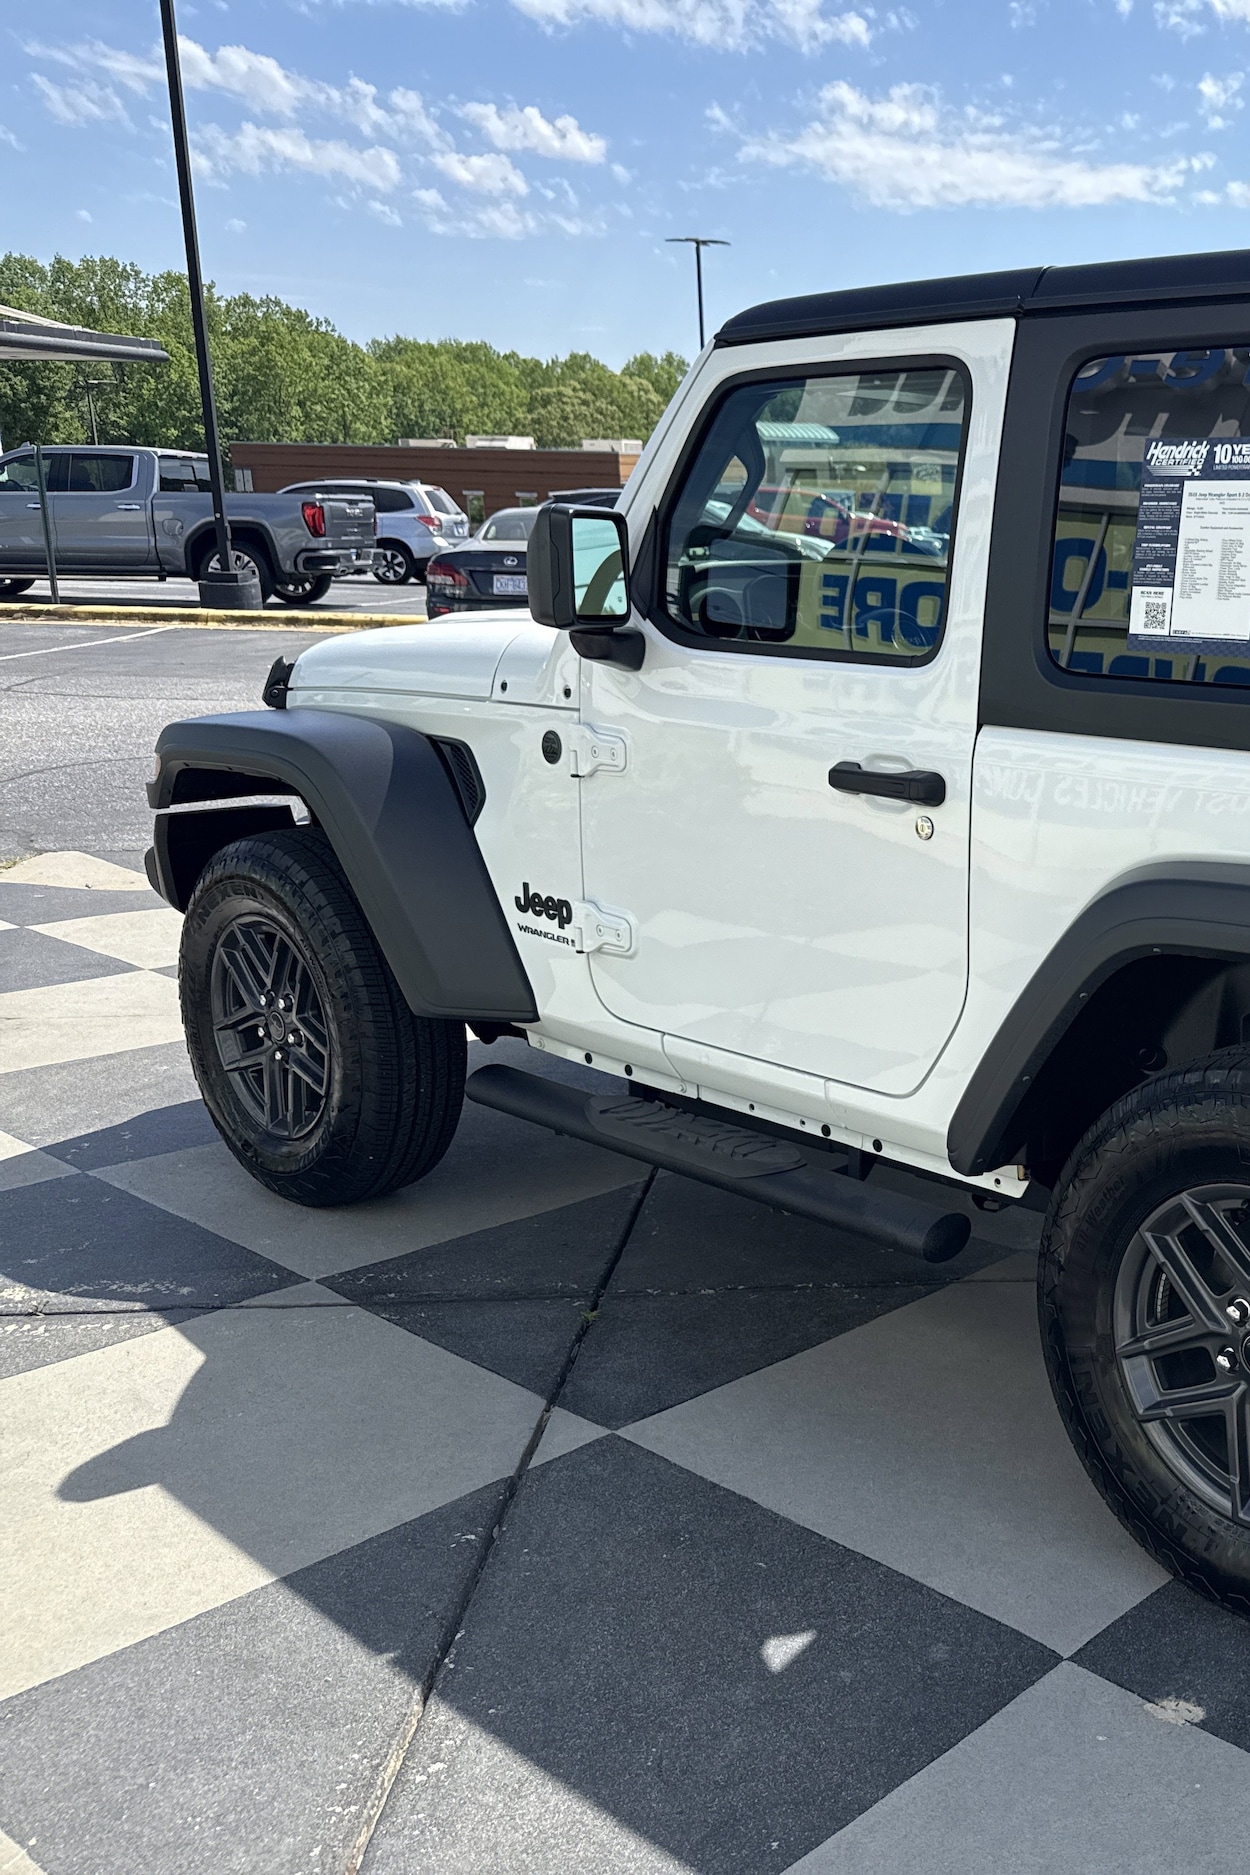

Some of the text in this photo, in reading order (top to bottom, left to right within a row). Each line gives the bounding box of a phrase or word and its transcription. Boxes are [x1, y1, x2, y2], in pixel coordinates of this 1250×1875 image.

[1146, 440, 1210, 465] Hendrick
[1154, 458, 1205, 466] CERTIFIED
[1213, 444, 1232, 464] 10
[514, 882, 573, 930] Jeep
[517, 923, 570, 946] WRANGLER
